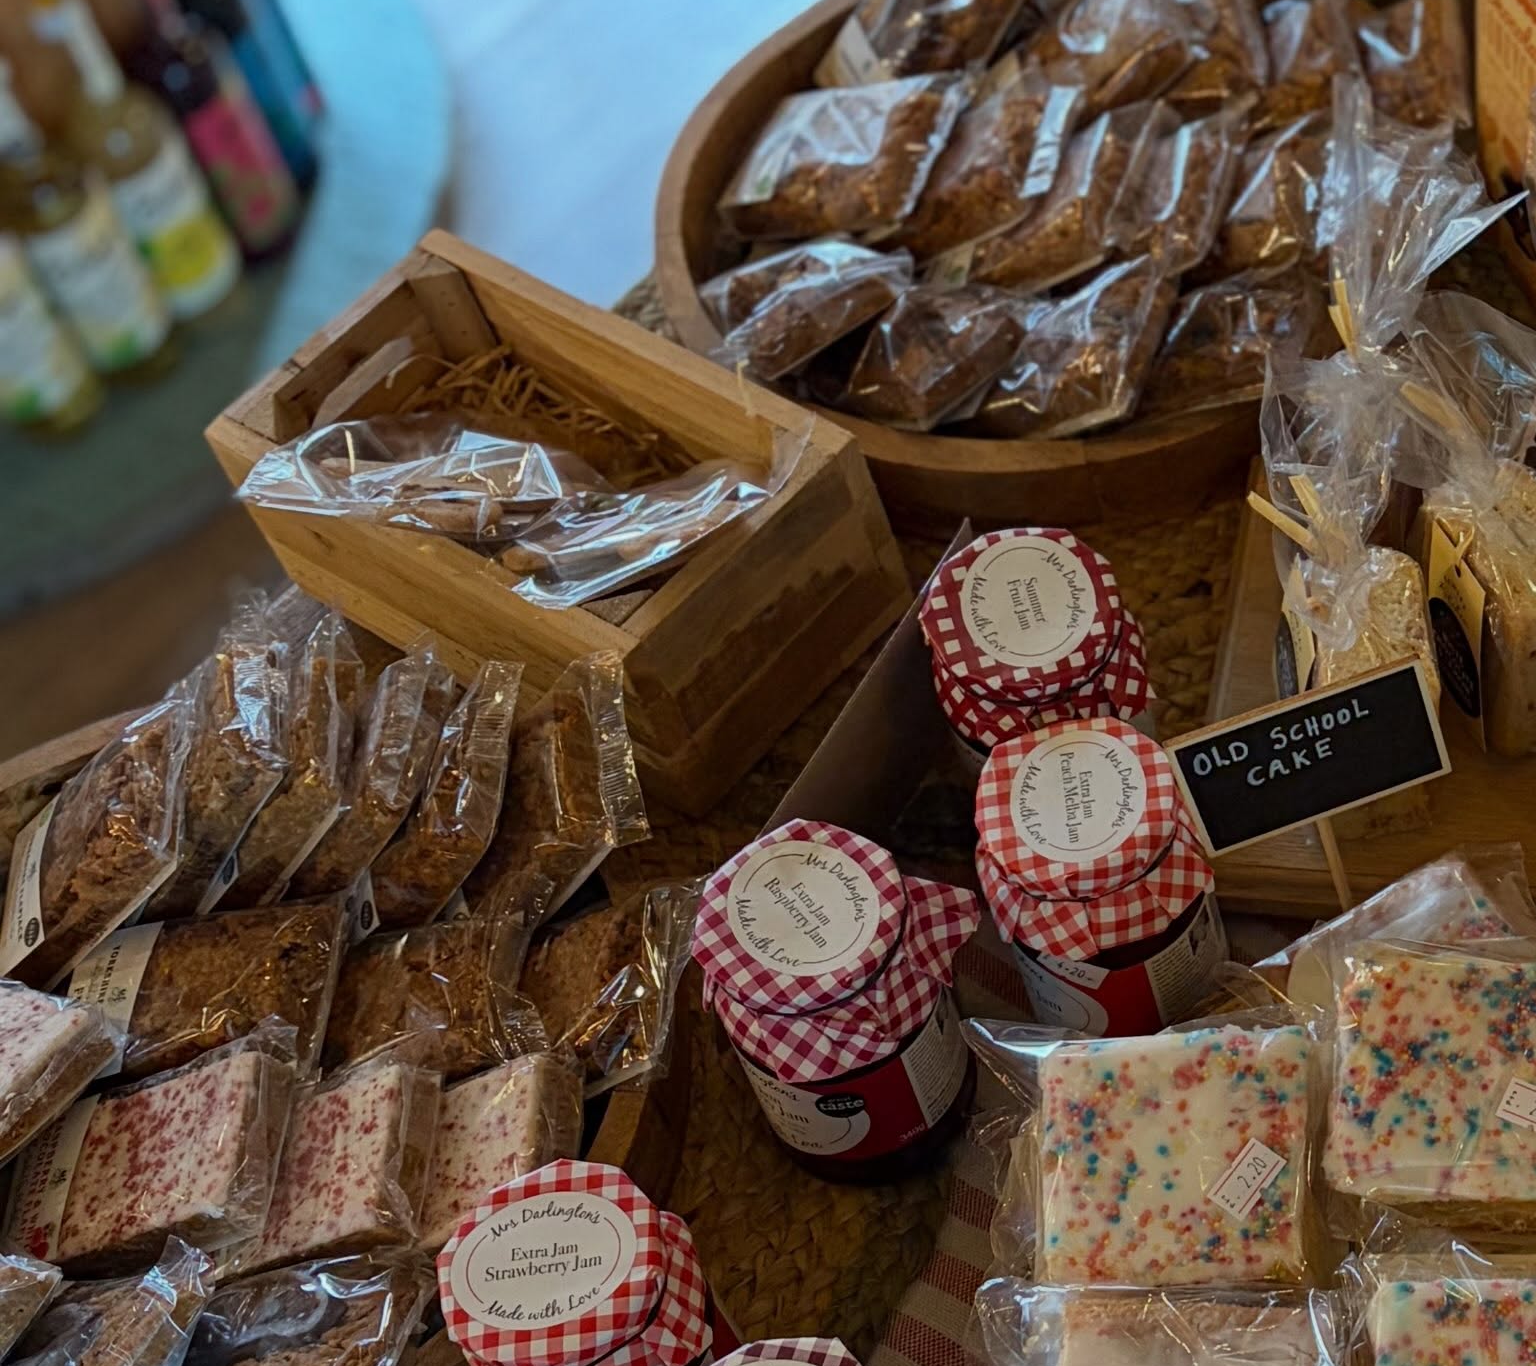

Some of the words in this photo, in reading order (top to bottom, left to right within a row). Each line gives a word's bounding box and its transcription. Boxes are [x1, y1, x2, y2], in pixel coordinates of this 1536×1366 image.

[970, 572, 987, 606] Made
[1007, 579, 1023, 607] Fruit
[1024, 577, 1046, 623] Summer
[1041, 552, 1064, 572] Mrs
[1063, 570, 1086, 629] Darlington's
[971, 608, 992, 632] with
[1014, 608, 1031, 630] Jam
[984, 631, 1006, 653] Love
[1193, 742, 1248, 775] OLD
[1270, 698, 1370, 750] SCHOOL
[1020, 760, 1041, 795] Made
[1059, 752, 1076, 784] Peach
[1247, 737, 1333, 786] CAKE
[1079, 771, 1092, 798] Extra
[1100, 749, 1123, 768] Mrs
[1112, 767, 1138, 828] Darlington's
[1019, 798, 1039, 822] with
[1081, 799, 1096, 819] Jam
[1025, 823, 1047, 845] Love
[1066, 822, 1082, 844] Jam
[800, 853, 828, 870] Mrs
[829, 862, 868, 923] Darlington's
[763, 877, 809, 929] Raspberry
[804, 925, 828, 949] Jam
[791, 882, 814, 909] Extra
[808, 905, 831, 927] Jam
[734, 895, 757, 930] Made
[746, 930, 775, 954] with
[769, 948, 801, 967] Love
[1056, 961, 1086, 978] 4.20
[819, 1097, 865, 1111] taste
[491, 1218, 519, 1242] Mrs
[522, 1200, 600, 1224] Darlington's
[511, 1246, 548, 1262] Extra
[550, 1242, 578, 1258] Jam
[484, 1260, 570, 1283] Strawberry
[572, 1255, 602, 1271] Jam
[482, 1300, 525, 1320] Made
[528, 1299, 564, 1321] with
[568, 1287, 600, 1311] Love
